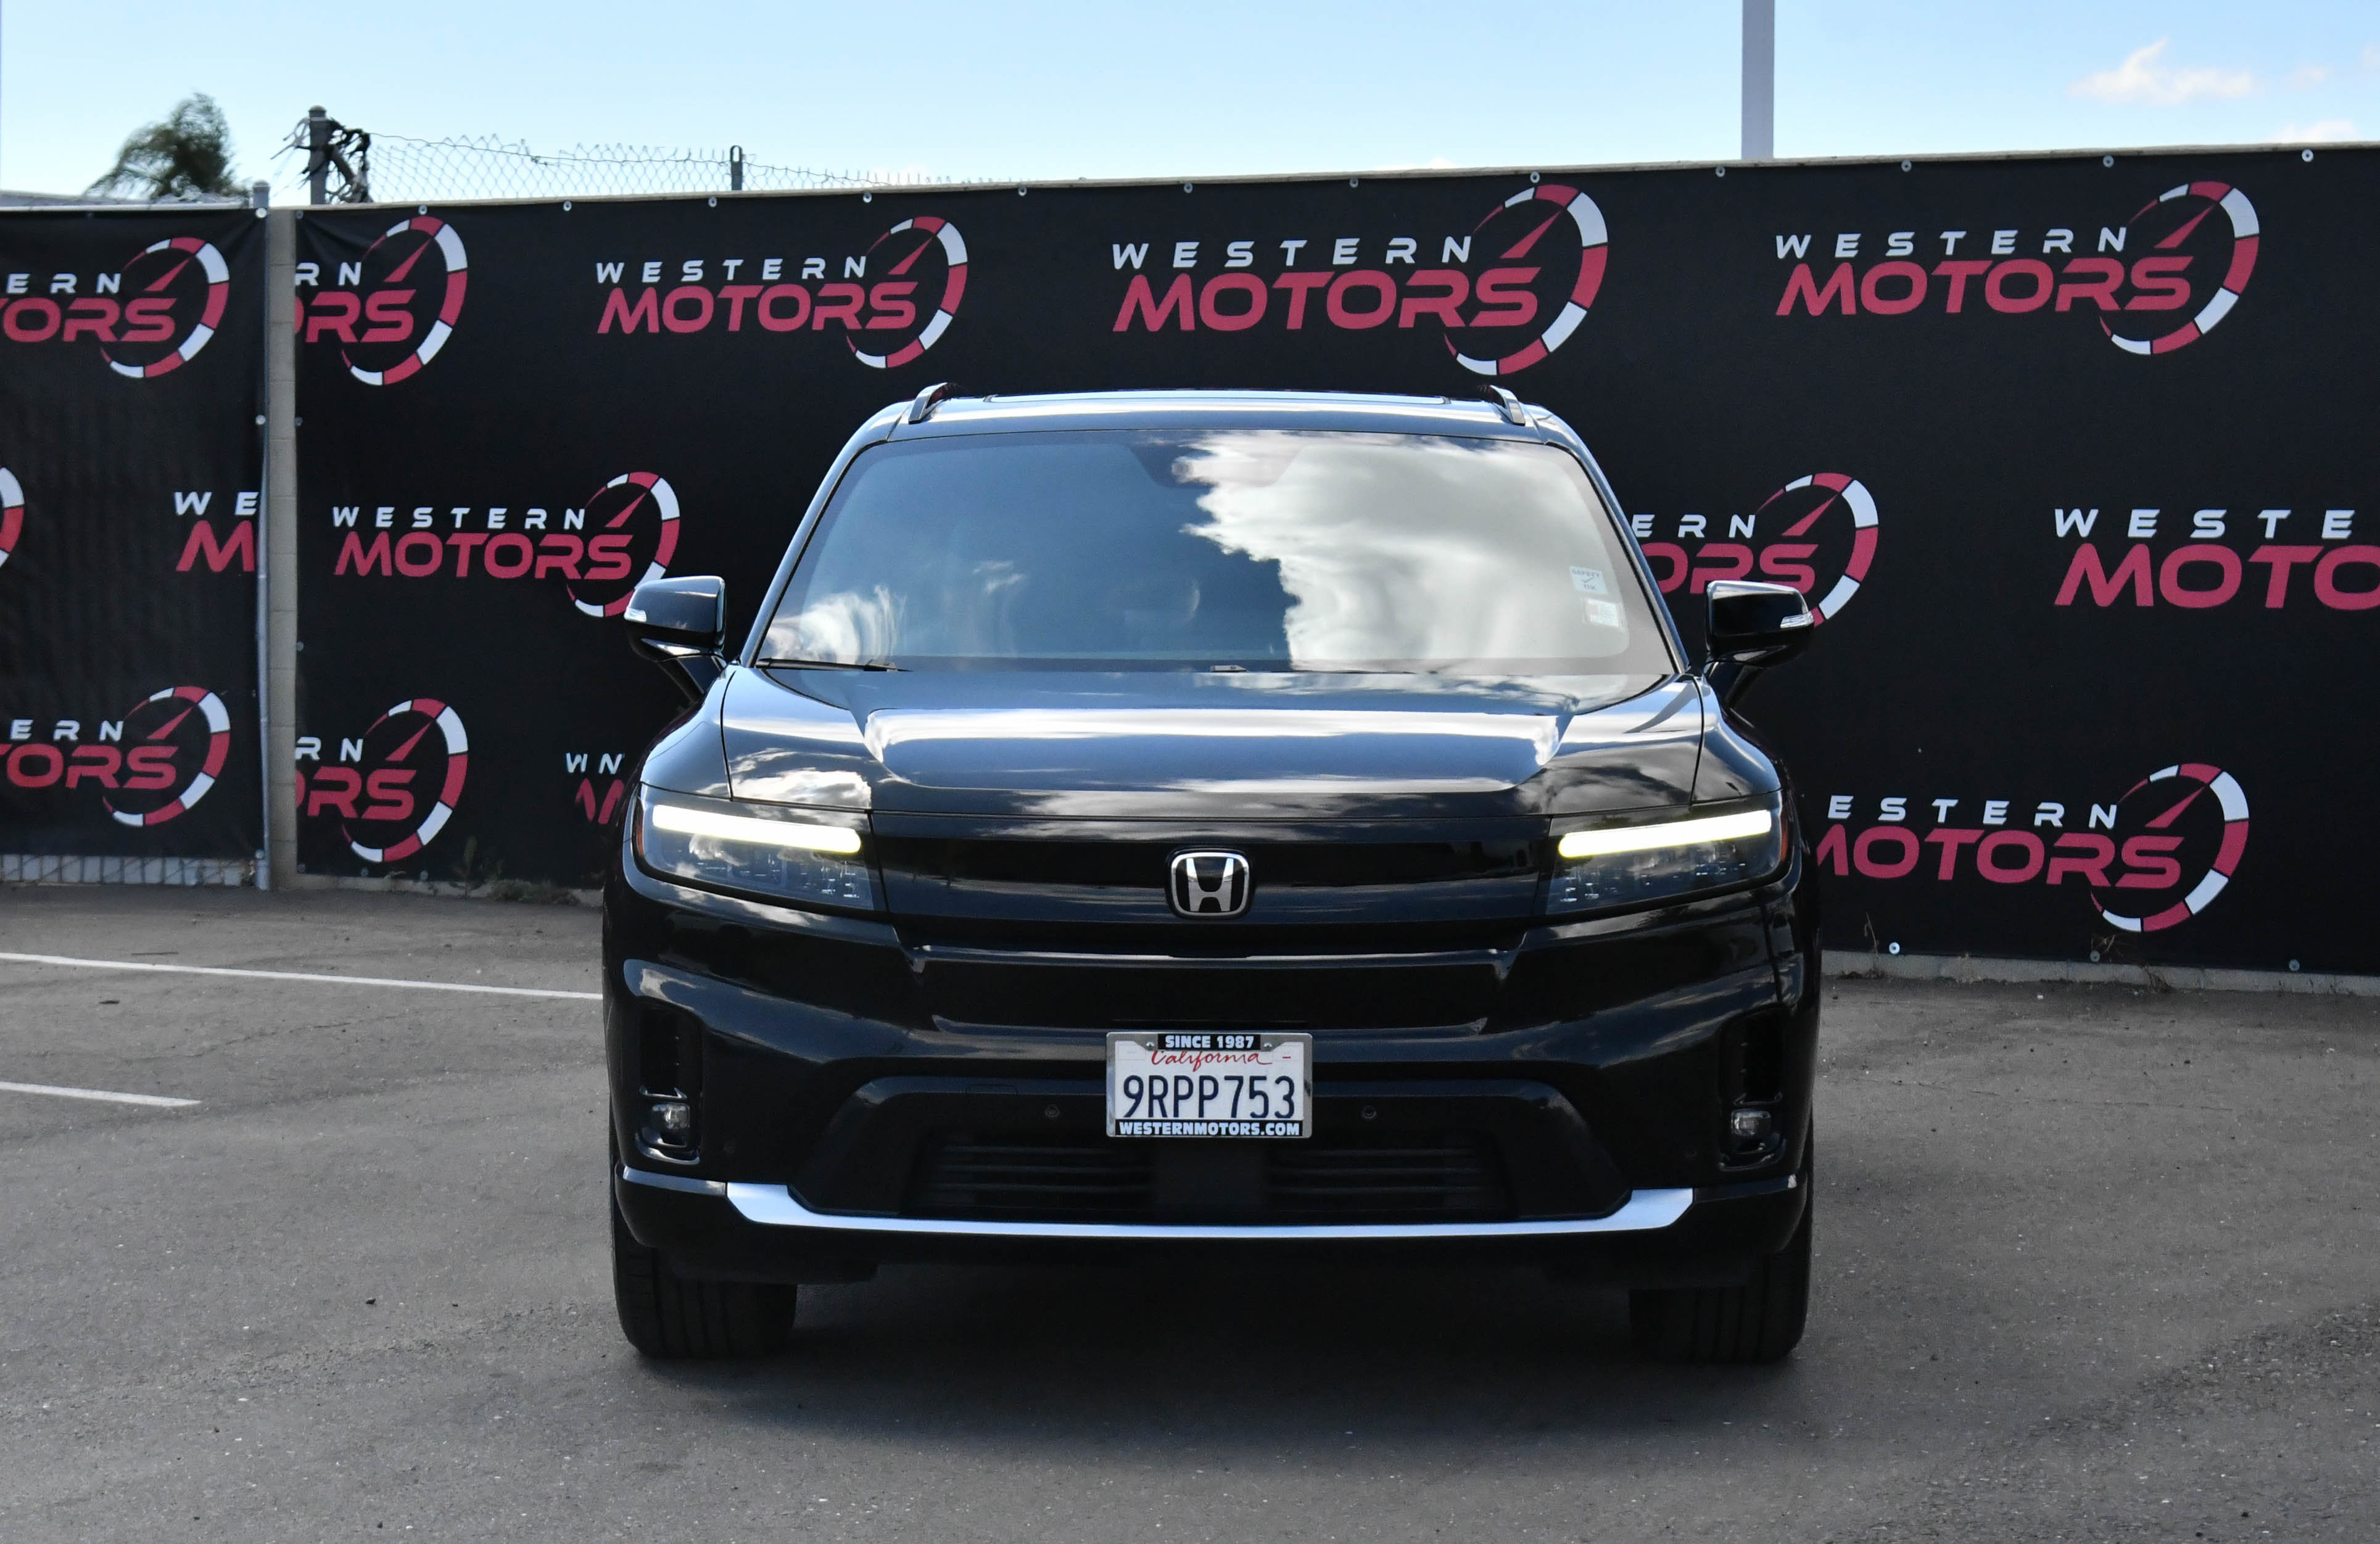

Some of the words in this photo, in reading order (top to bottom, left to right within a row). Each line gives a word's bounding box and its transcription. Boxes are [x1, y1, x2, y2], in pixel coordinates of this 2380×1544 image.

[1112, 235, 1472, 270] WESTERN
[1776, 226, 2127, 259] WESTERN
[595, 255, 866, 284] WESTERN
[1775, 255, 2194, 316] MOTORS
[0, 297, 178, 342] ORS
[295, 289, 416, 343] RS
[597, 281, 918, 334] MOTORS
[1112, 269, 1542, 332] MOTORS
[333, 506, 585, 530] WESTERN
[2054, 508, 2355, 540] WESTE
[334, 531, 634, 580] MOTORS
[0, 743, 178, 790] ORS
[296, 766, 416, 820] RS
[1827, 795, 2118, 829] ESTERN
[1151, 1050, 1273, 1072] California
[1165, 1034, 1210, 1048] SINCE
[1217, 1035, 1254, 1049] 1987
[1123, 1075, 1295, 1119] 9RPP753
[1119, 1121, 1300, 1136] WESTERNMOTORS.COM
